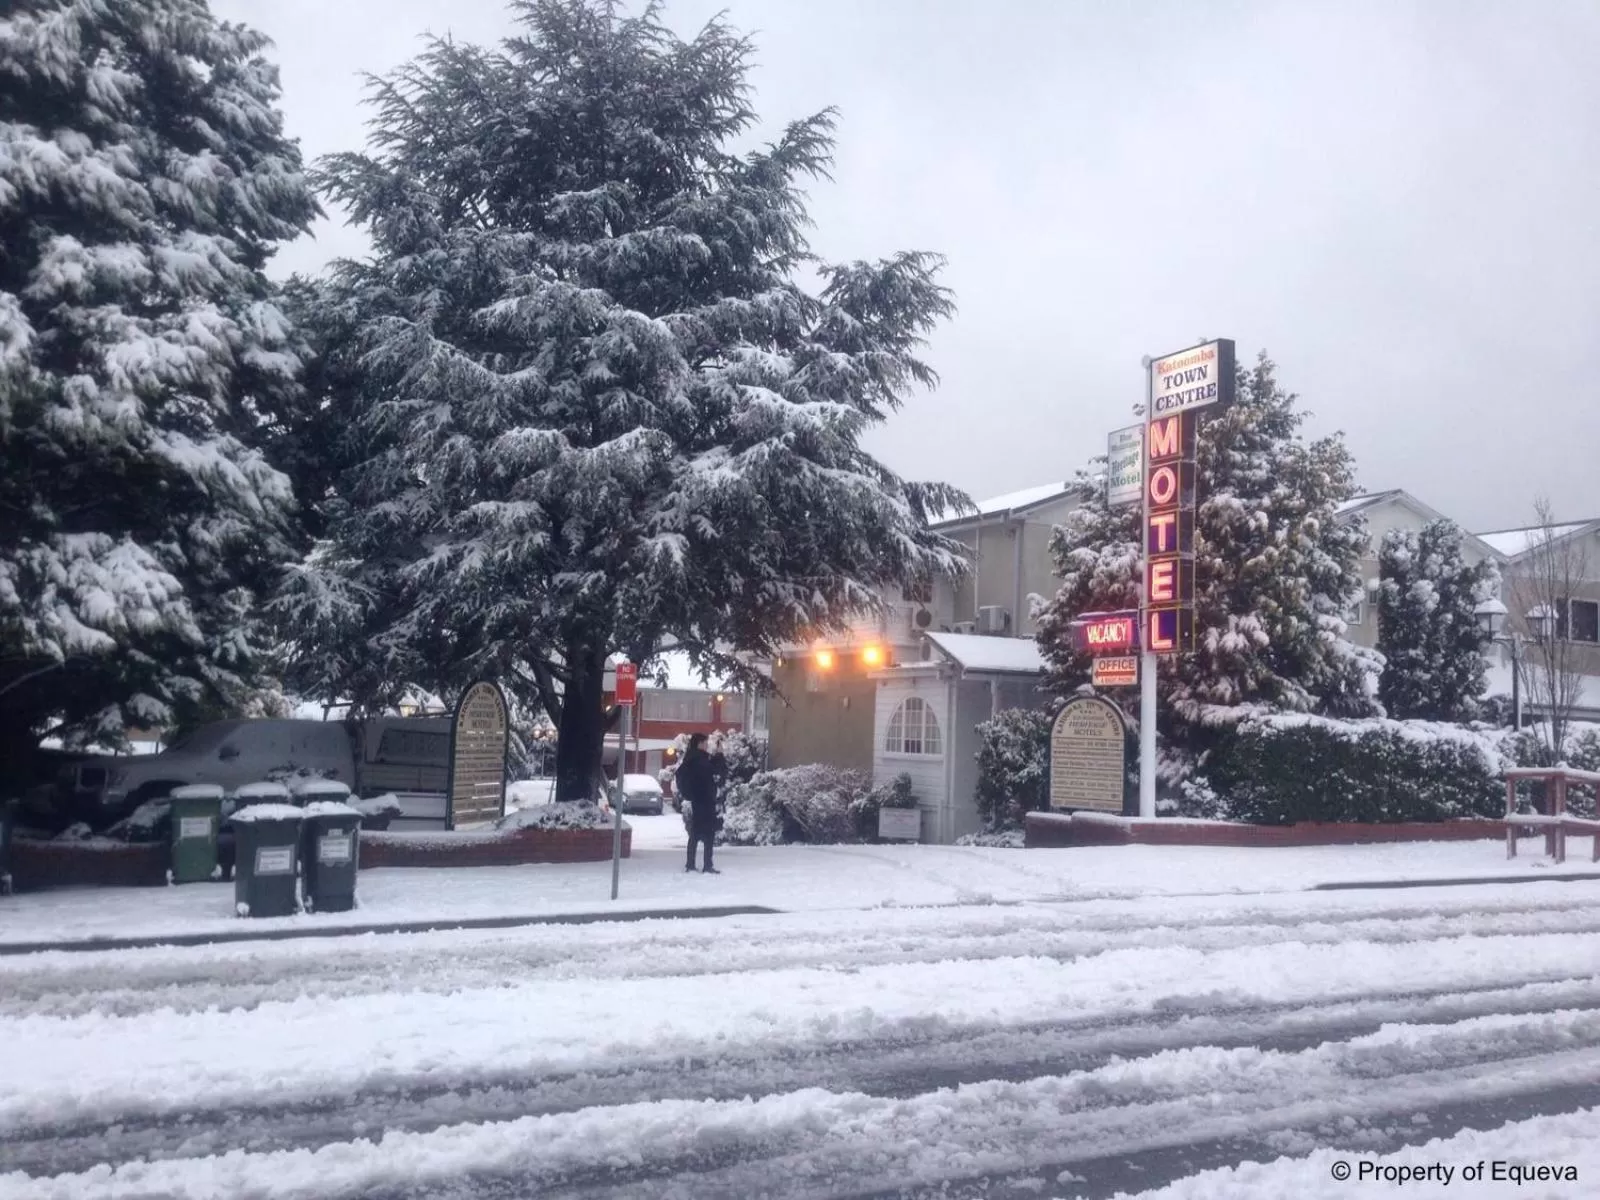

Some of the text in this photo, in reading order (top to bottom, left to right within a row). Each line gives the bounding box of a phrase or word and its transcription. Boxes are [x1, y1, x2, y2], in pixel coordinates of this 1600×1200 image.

[1157, 349, 1215, 374] Katoomba
[1164, 365, 1208, 389] TOWN
[1156, 383, 1216, 411] CENTRE
[1110, 472, 1141, 489] Motel
[1150, 416, 1178, 649] MOTEL
[1087, 622, 1127, 645] VACANCY
[1099, 659, 1136, 671] OFFICE
